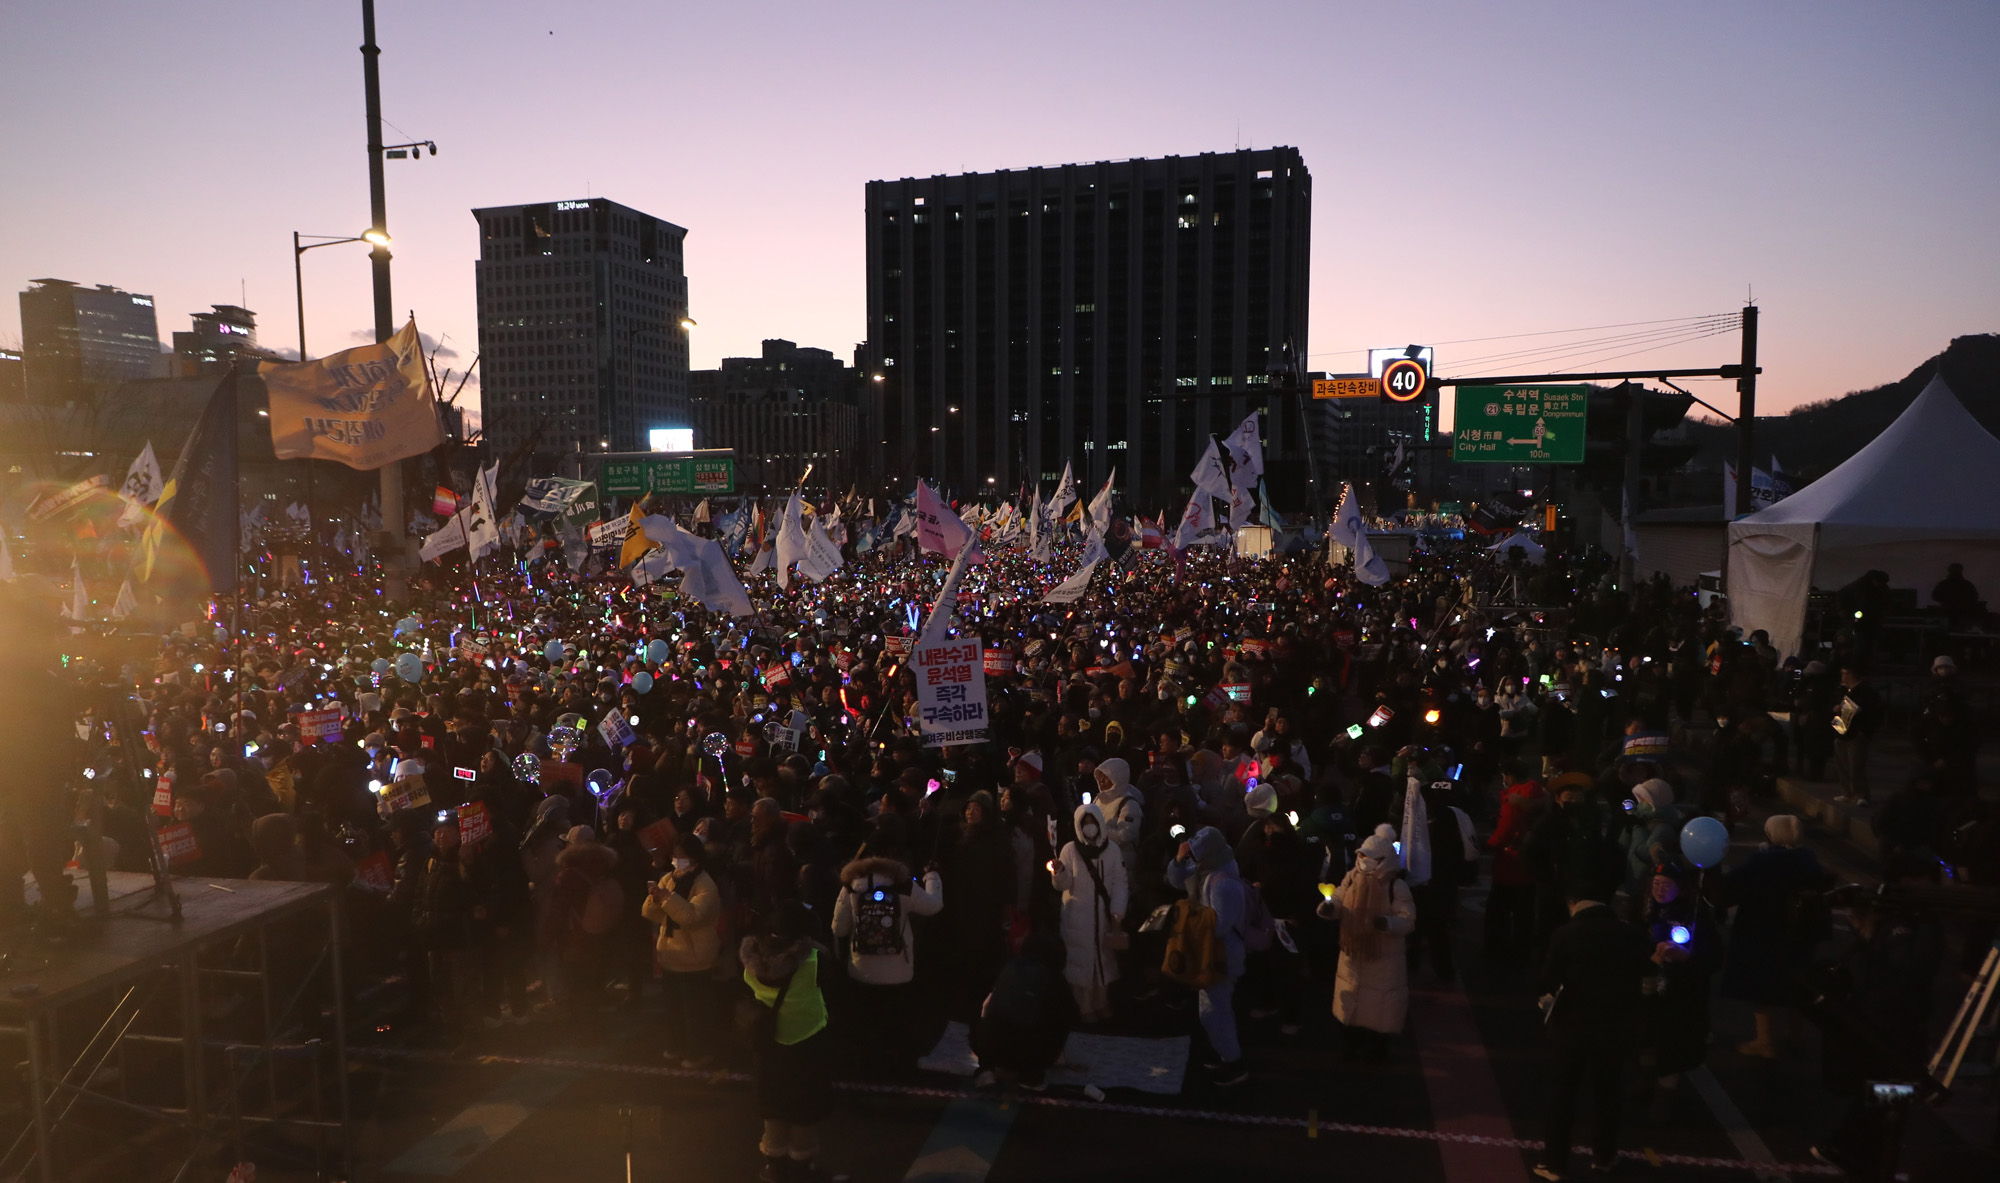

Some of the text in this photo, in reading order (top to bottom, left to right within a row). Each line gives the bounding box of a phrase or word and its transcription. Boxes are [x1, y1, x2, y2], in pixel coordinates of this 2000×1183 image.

[1392, 371, 1416, 390] 40
[1316, 381, 1378, 395] 과속단속장비
[1503, 389, 1584, 401] 수색역 Susaek Stn
[1488, 406, 1497, 414] 21
[1502, 403, 1540, 416] 독립문
[1543, 410, 1584, 419] Dongnimmun
[1459, 429, 1482, 441] 시청
[1459, 443, 1496, 453] City Hall
[1529, 450, 1551, 459] 100m
[608, 466, 639, 476] 종로구청
[695, 463, 727, 471] 삼청터널
[918, 644, 978, 666] 내란수괴
[927, 664, 972, 685] 윤석열
[936, 684, 966, 703] 즉각
[923, 702, 983, 724] 구속하라
